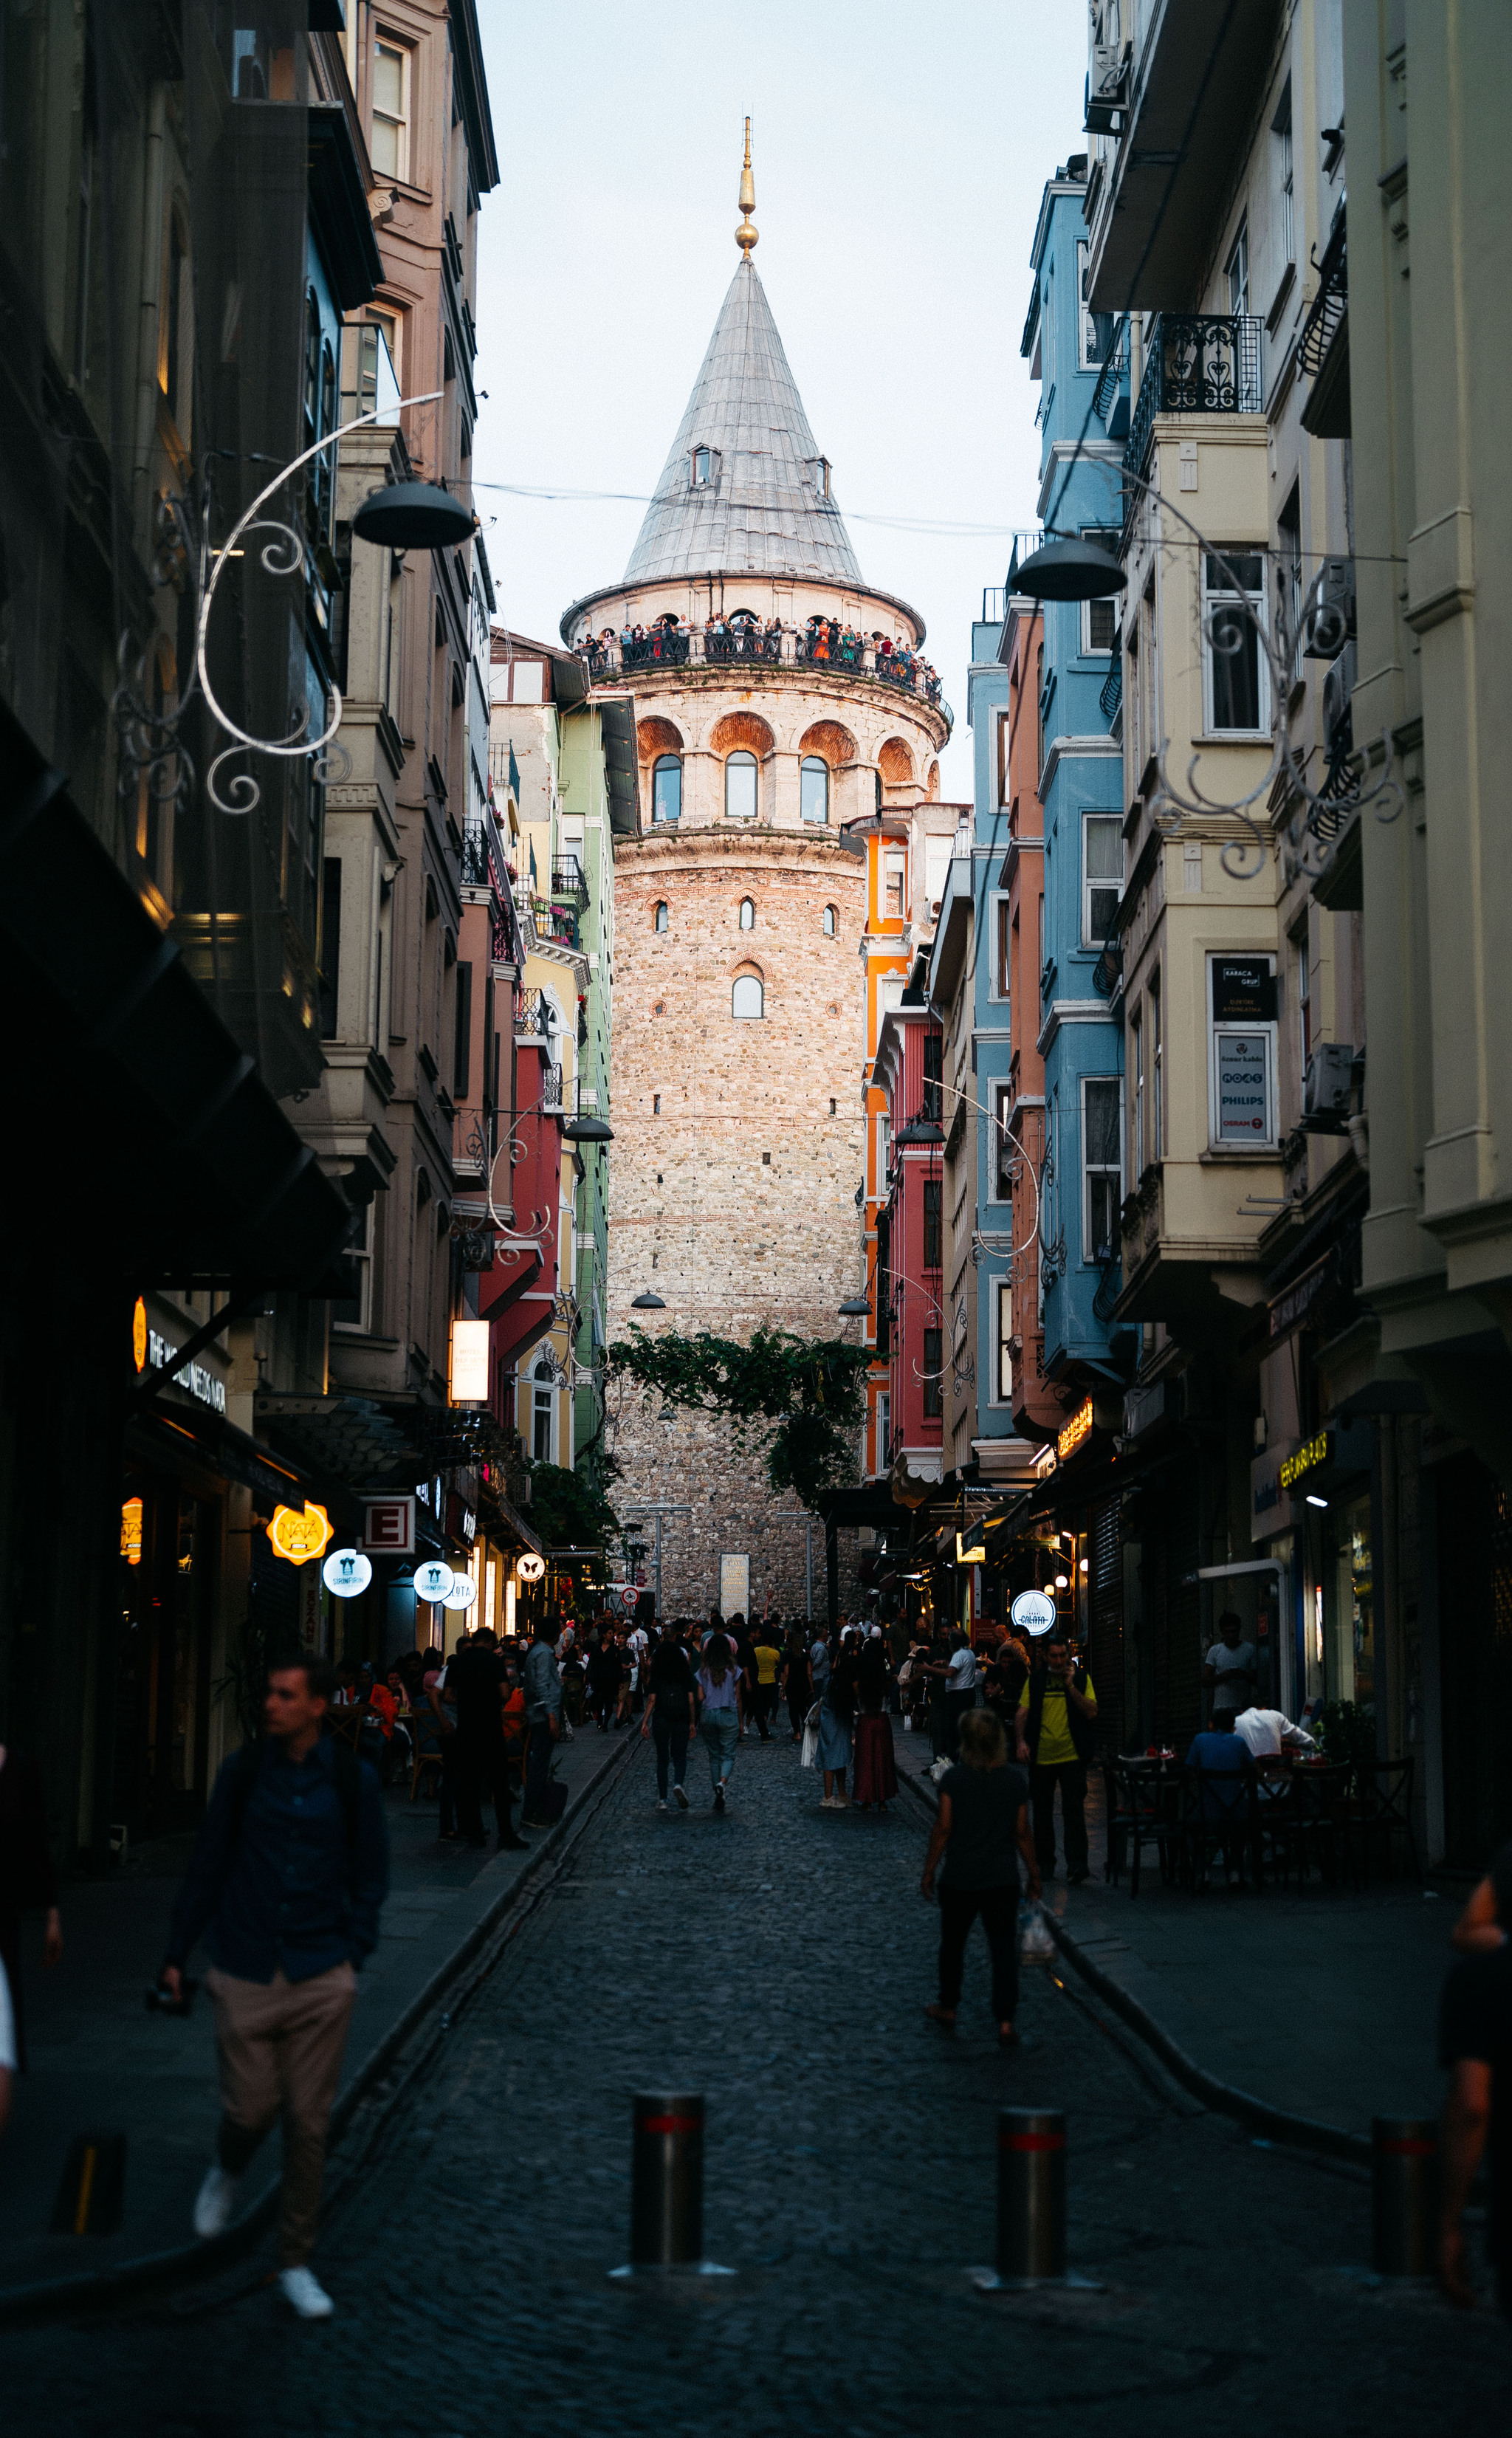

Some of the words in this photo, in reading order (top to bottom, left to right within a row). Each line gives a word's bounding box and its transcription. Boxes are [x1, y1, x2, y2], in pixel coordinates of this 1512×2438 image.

[1222, 1096, 1264, 1105] PHILIPS
[278, 1520, 321, 1543] NATA
[371, 1508, 399, 1542] E
[1021, 1615, 1045, 1624] GALATA
